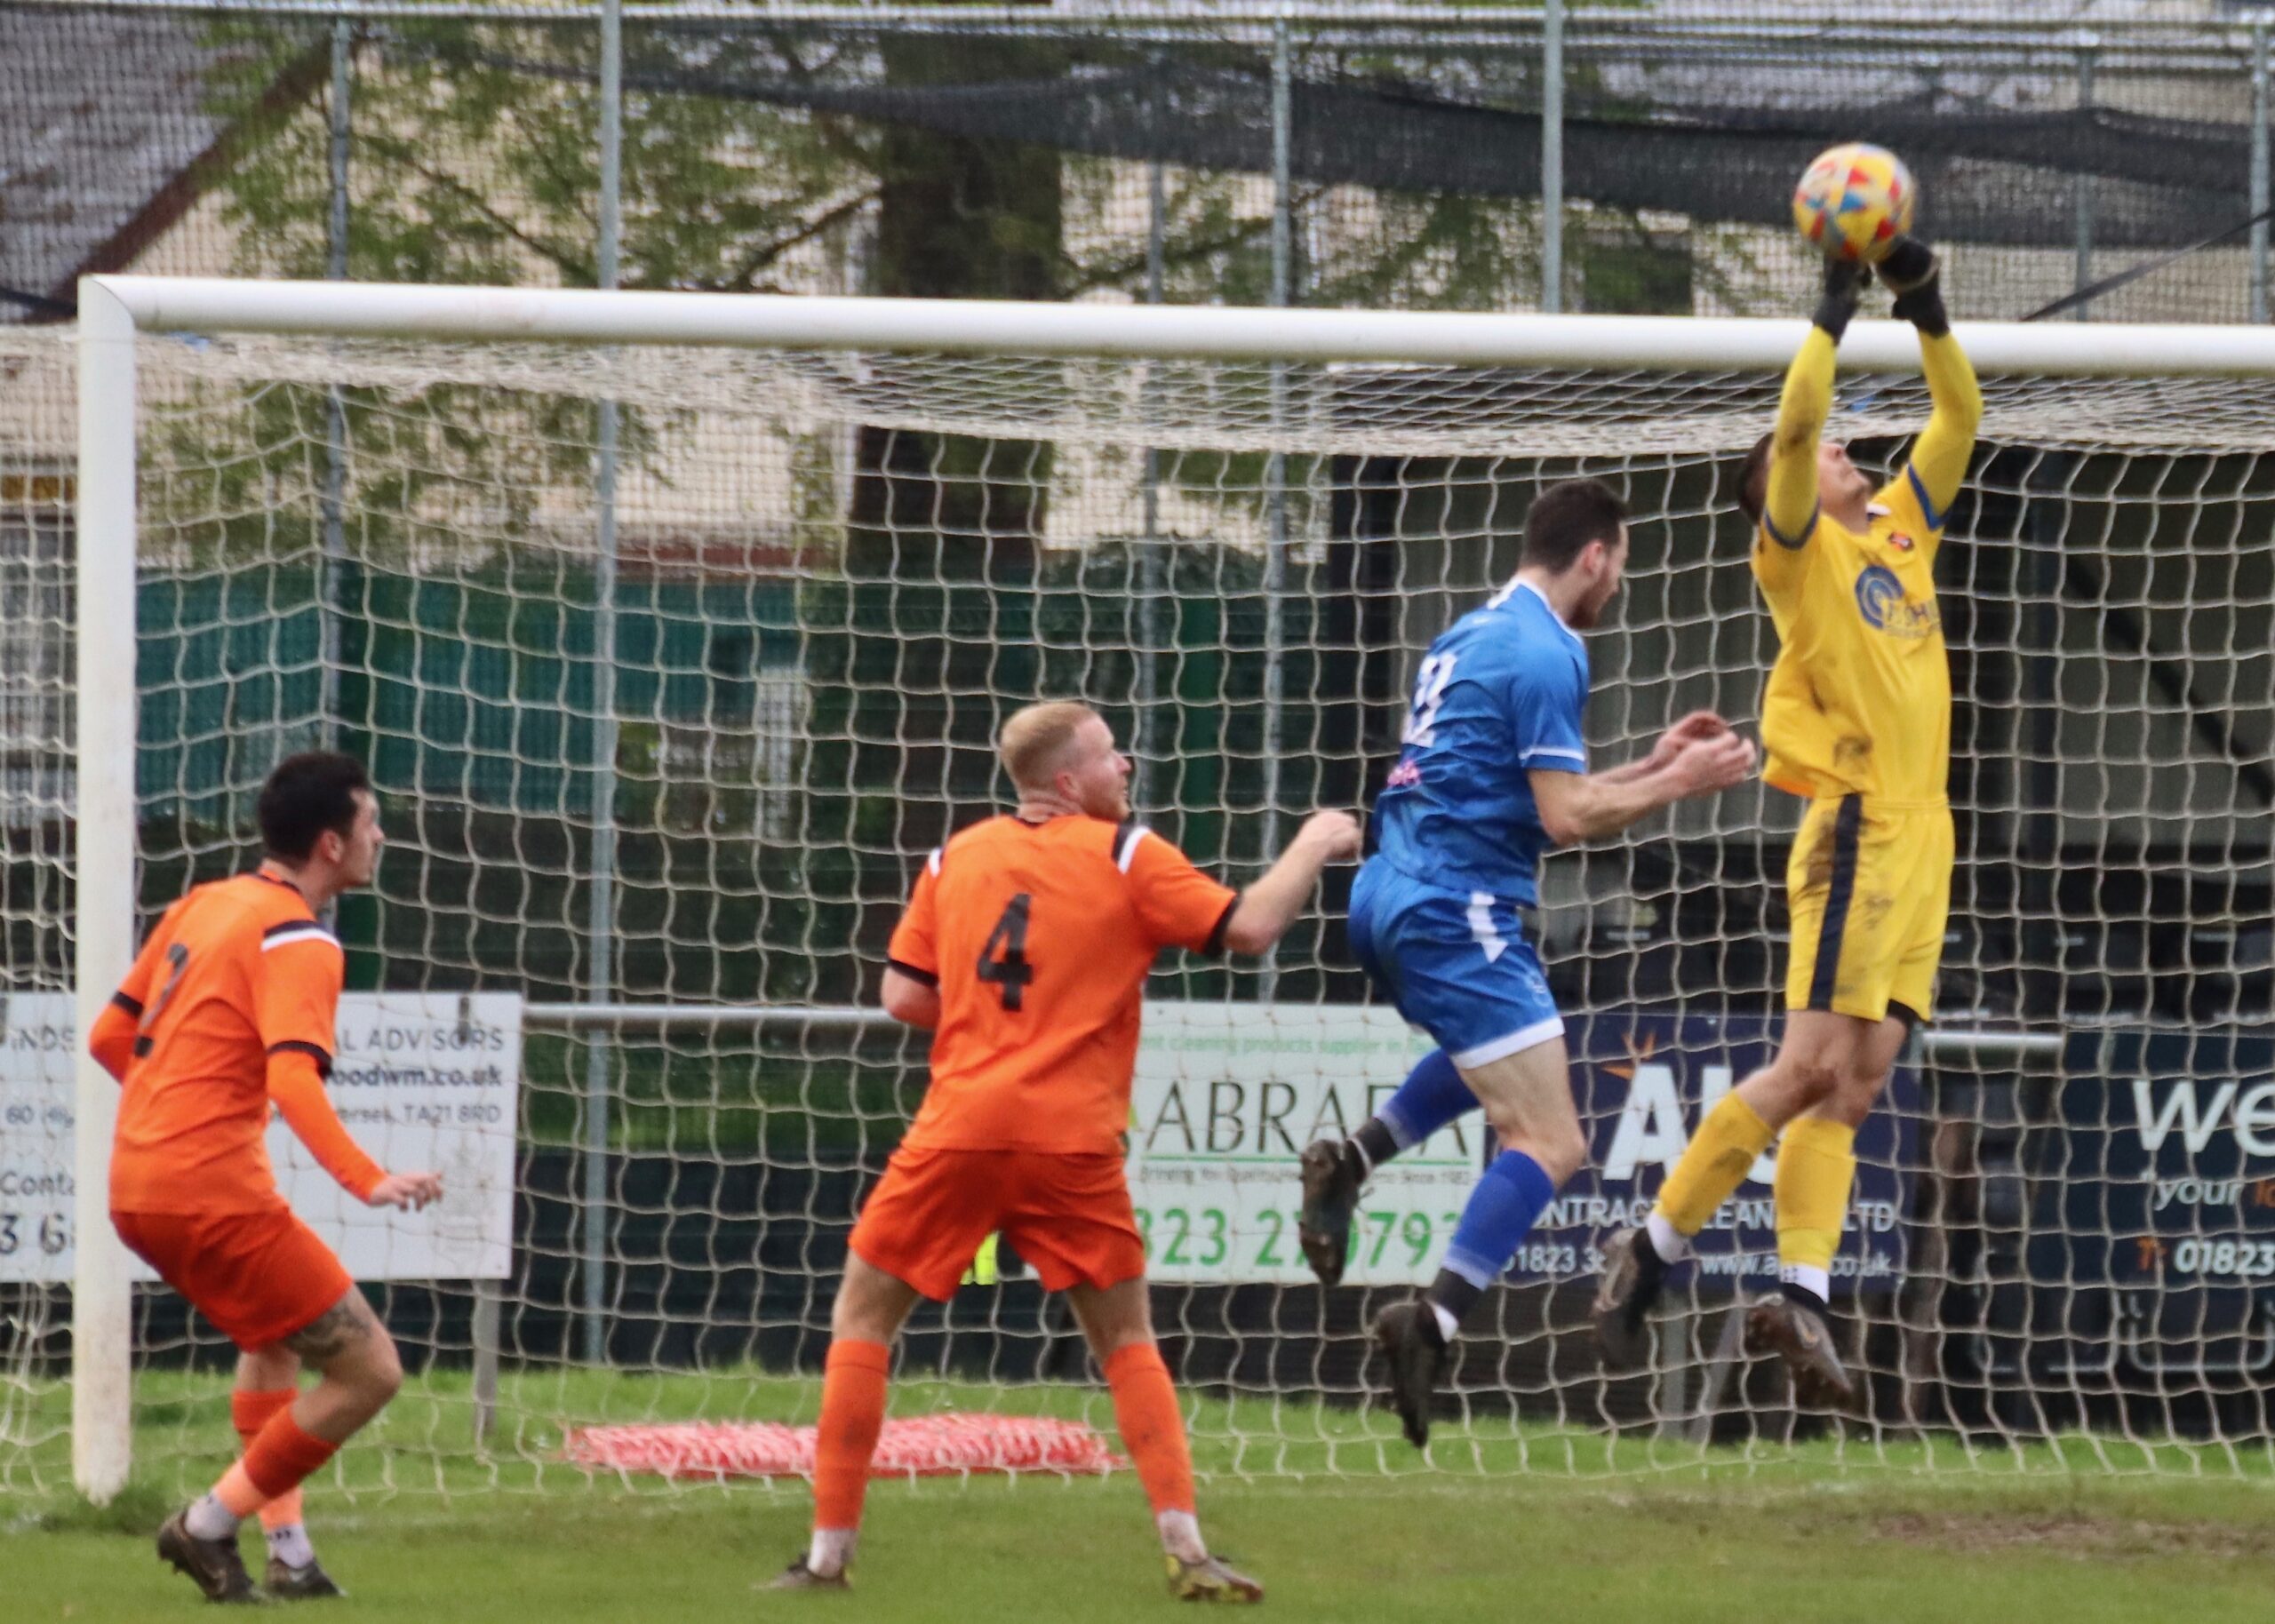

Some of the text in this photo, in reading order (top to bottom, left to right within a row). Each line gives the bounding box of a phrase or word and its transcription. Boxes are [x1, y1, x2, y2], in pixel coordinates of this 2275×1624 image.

[977, 891, 1034, 1013] 4
[336, 1026, 504, 1052] L ADVSORS
[331, 1064, 503, 1087] oodwm.co.uk
[2153, 1179, 2241, 1212] your
[2174, 1239, 2275, 1277] 01823
